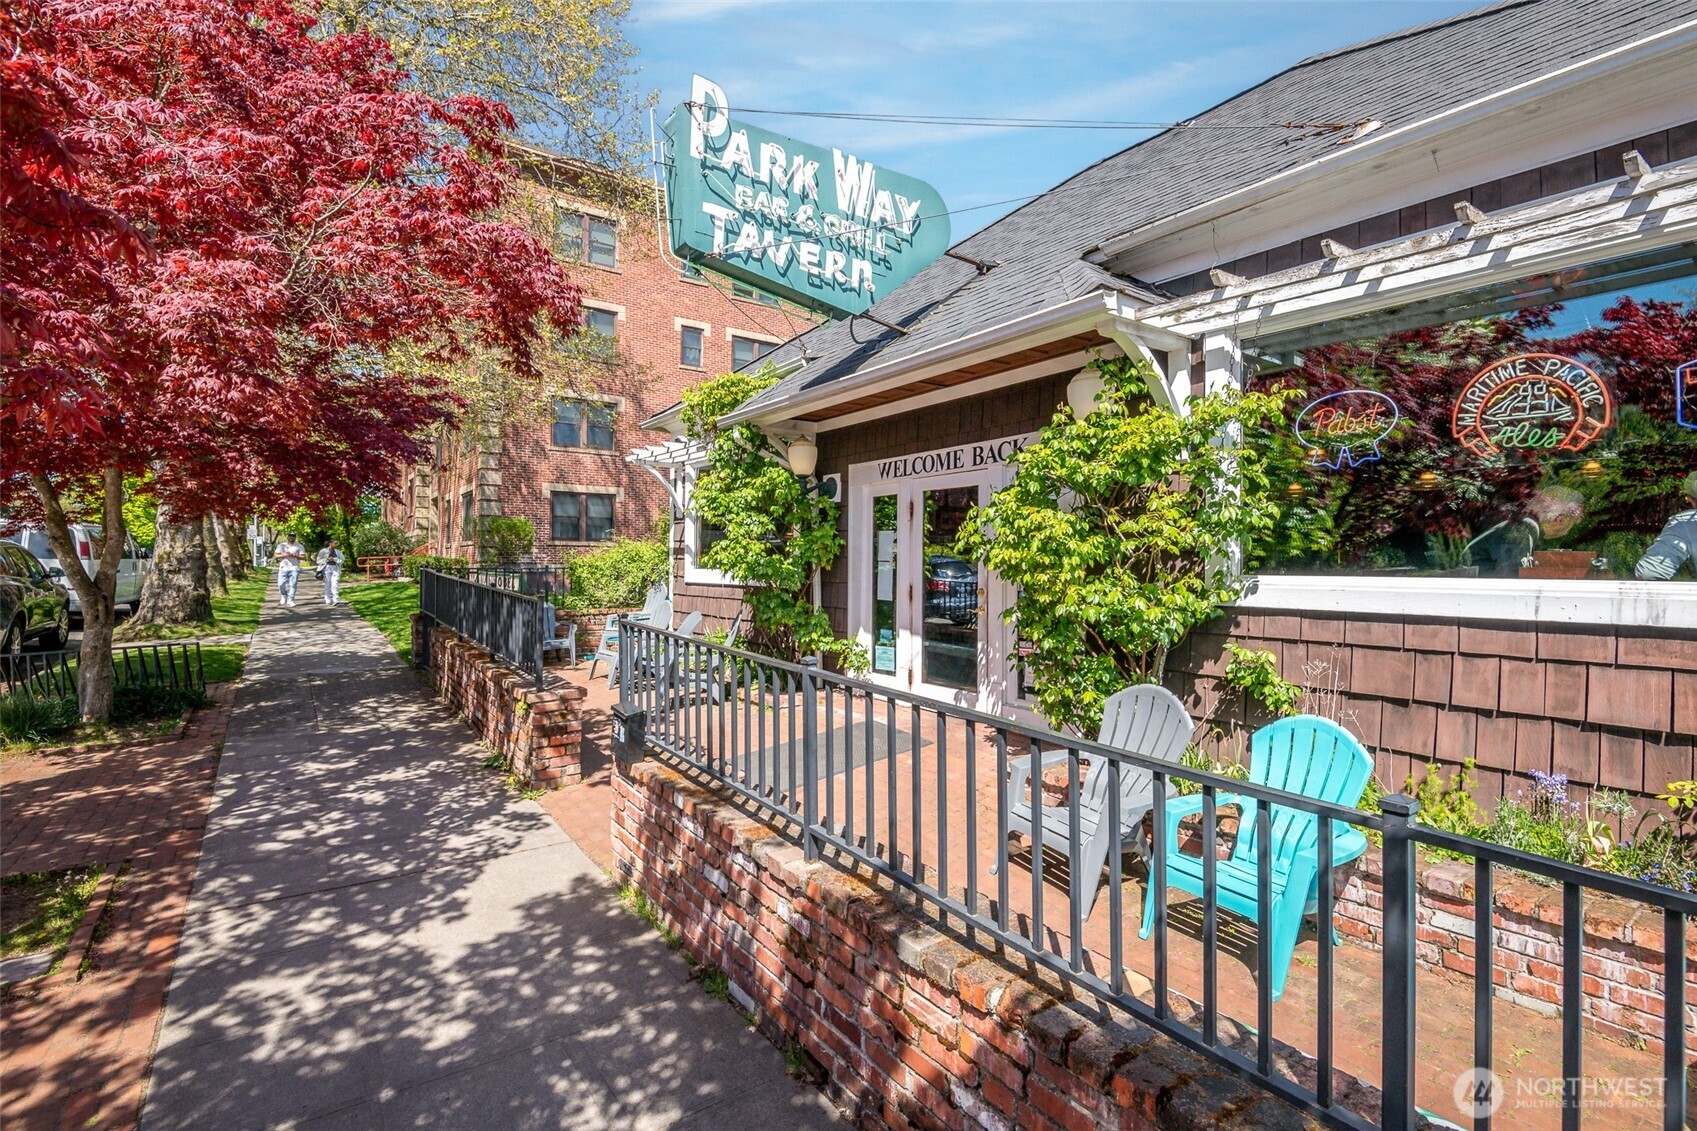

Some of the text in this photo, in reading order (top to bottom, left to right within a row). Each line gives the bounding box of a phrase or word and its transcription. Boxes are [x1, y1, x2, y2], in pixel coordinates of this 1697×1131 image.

[736, 184, 788, 222] BAR
[832, 148, 921, 234] WAY
[1458, 359, 1604, 426] MARITIME PACIFIC
[1312, 402, 1386, 437] Pabst
[878, 437, 1029, 480] WELCOME BACK
